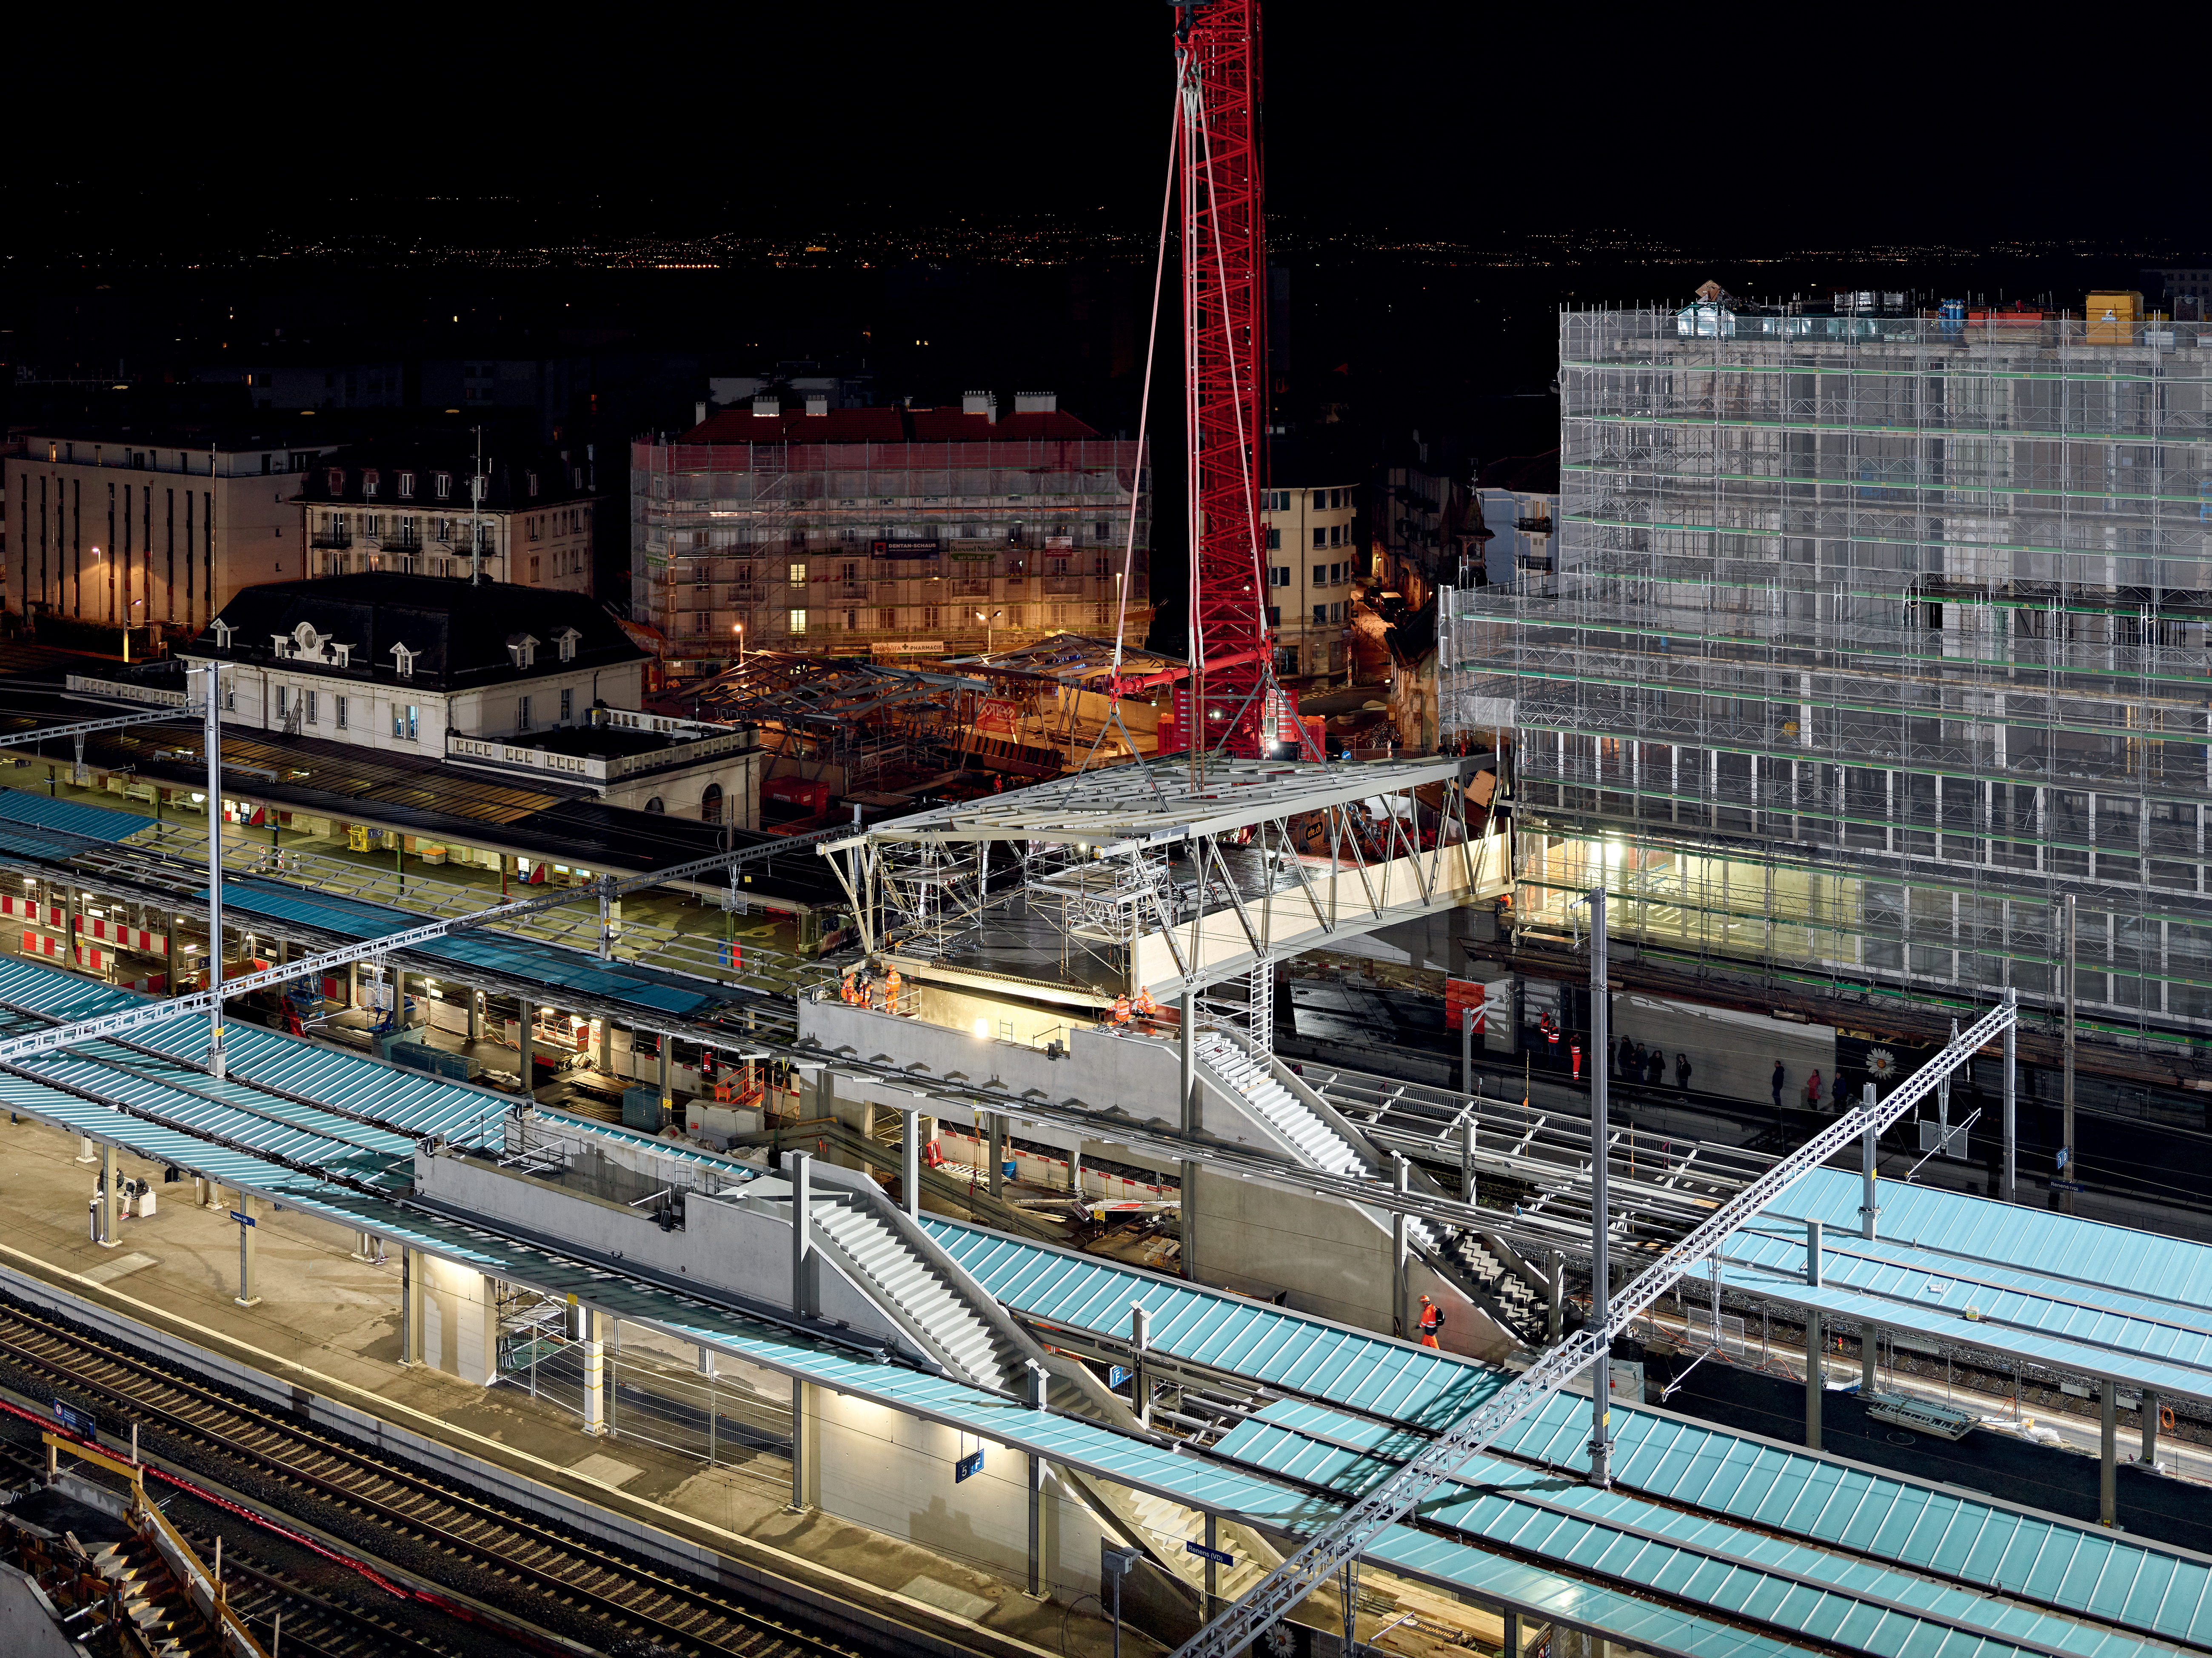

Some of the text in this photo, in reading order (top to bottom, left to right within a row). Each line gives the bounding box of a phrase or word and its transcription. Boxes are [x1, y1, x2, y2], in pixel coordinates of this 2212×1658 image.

[2058, 1153, 2067, 1165] 1 D
[2051, 1182, 2069, 1190] Renens
[231, 1213, 243, 1222] Renens
[1115, 1369, 1121, 1384] F
[961, 1458, 981, 1477] 5 F
[1187, 1545, 1223, 1563] Renens (VD)
